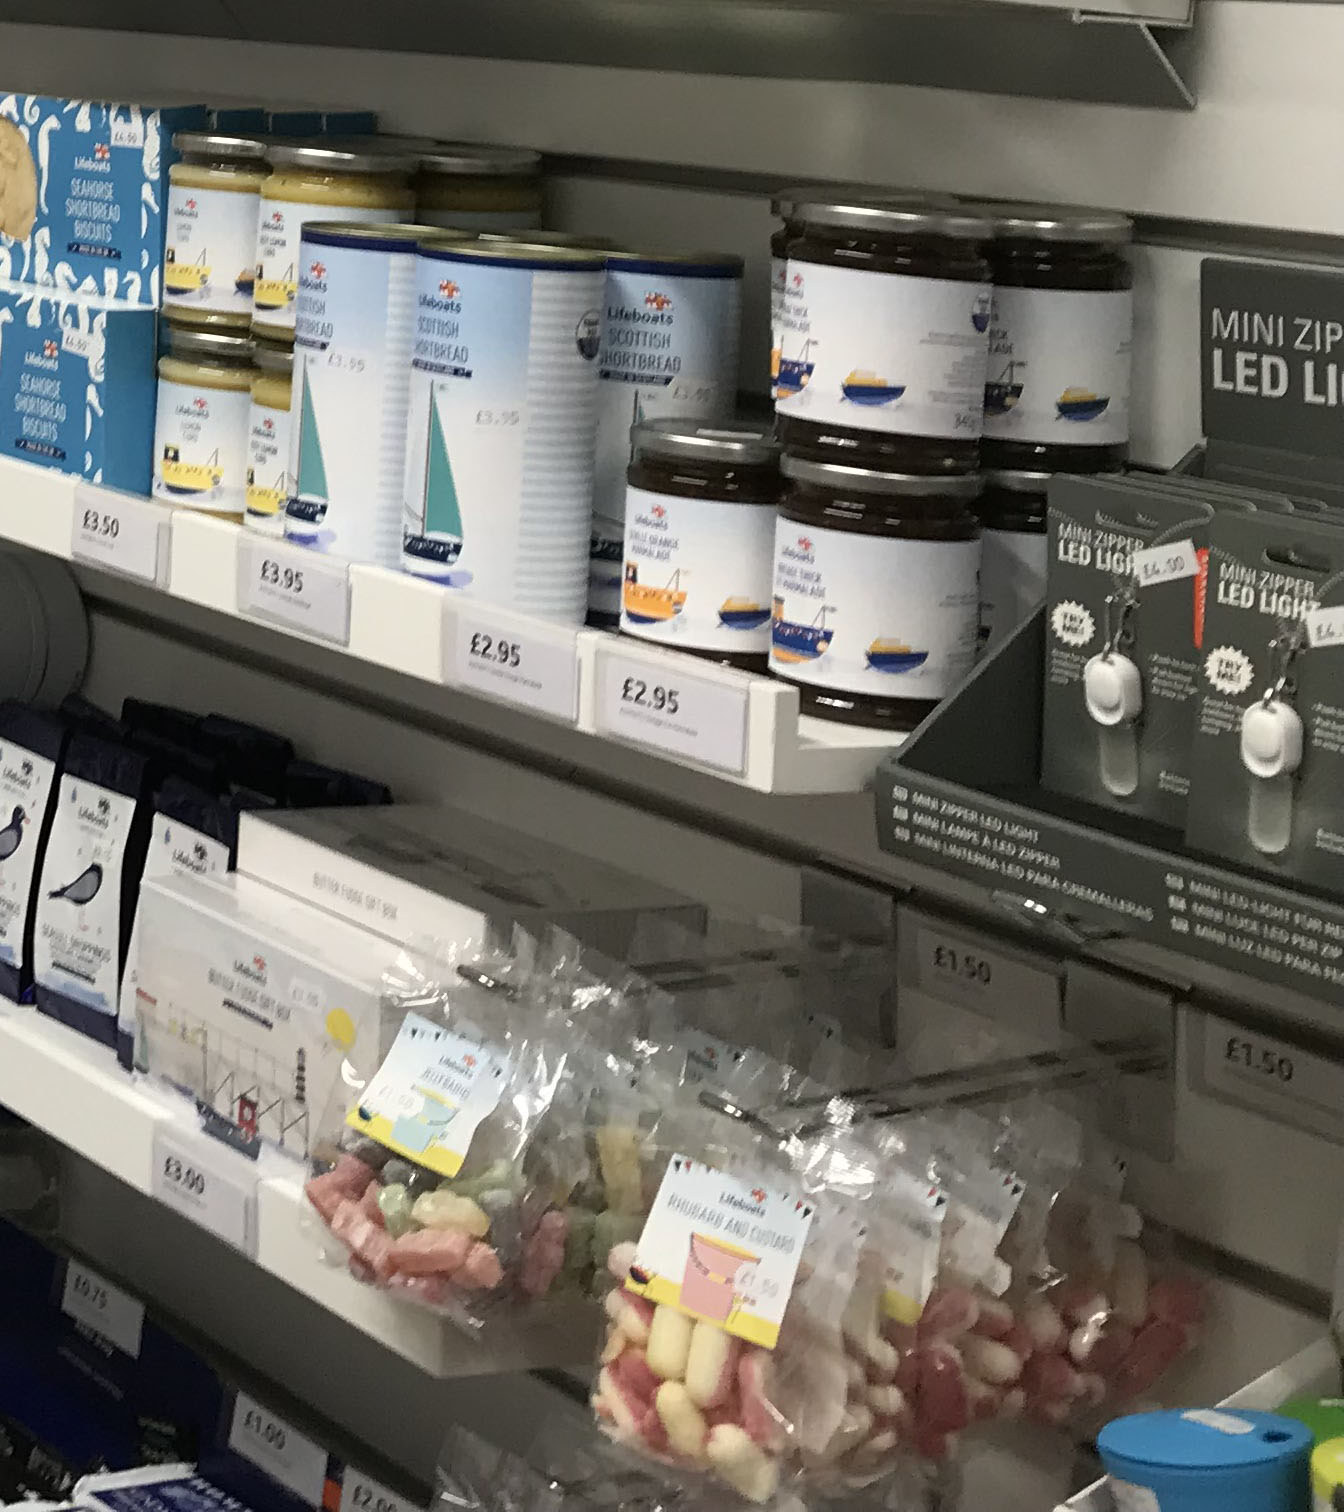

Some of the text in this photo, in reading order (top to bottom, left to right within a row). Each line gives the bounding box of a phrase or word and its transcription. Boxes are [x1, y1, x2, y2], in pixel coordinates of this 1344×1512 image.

[71, 179, 114, 200] SEAHORSE
[65, 198, 120, 222] SHORTBREAD
[75, 221, 112, 242] BISCUITS
[608, 329, 671, 348] SCOTTISH
[1212, 308, 1284, 347] MINI
[1213, 348, 1344, 407] LED LI
[83, 510, 119, 536] £3.50
[1058, 523, 1092, 545] MINI
[1057, 544, 1138, 578] LED LIGH
[1219, 563, 1255, 587] MINI
[261, 561, 303, 592] £3.95
[1217, 583, 1254, 608] LED
[470, 633, 520, 666] £2.95
[622, 678, 680, 714] £2.95
[1226, 1037, 1293, 1082] £1.50
[164, 1157, 204, 1194] £3.00
